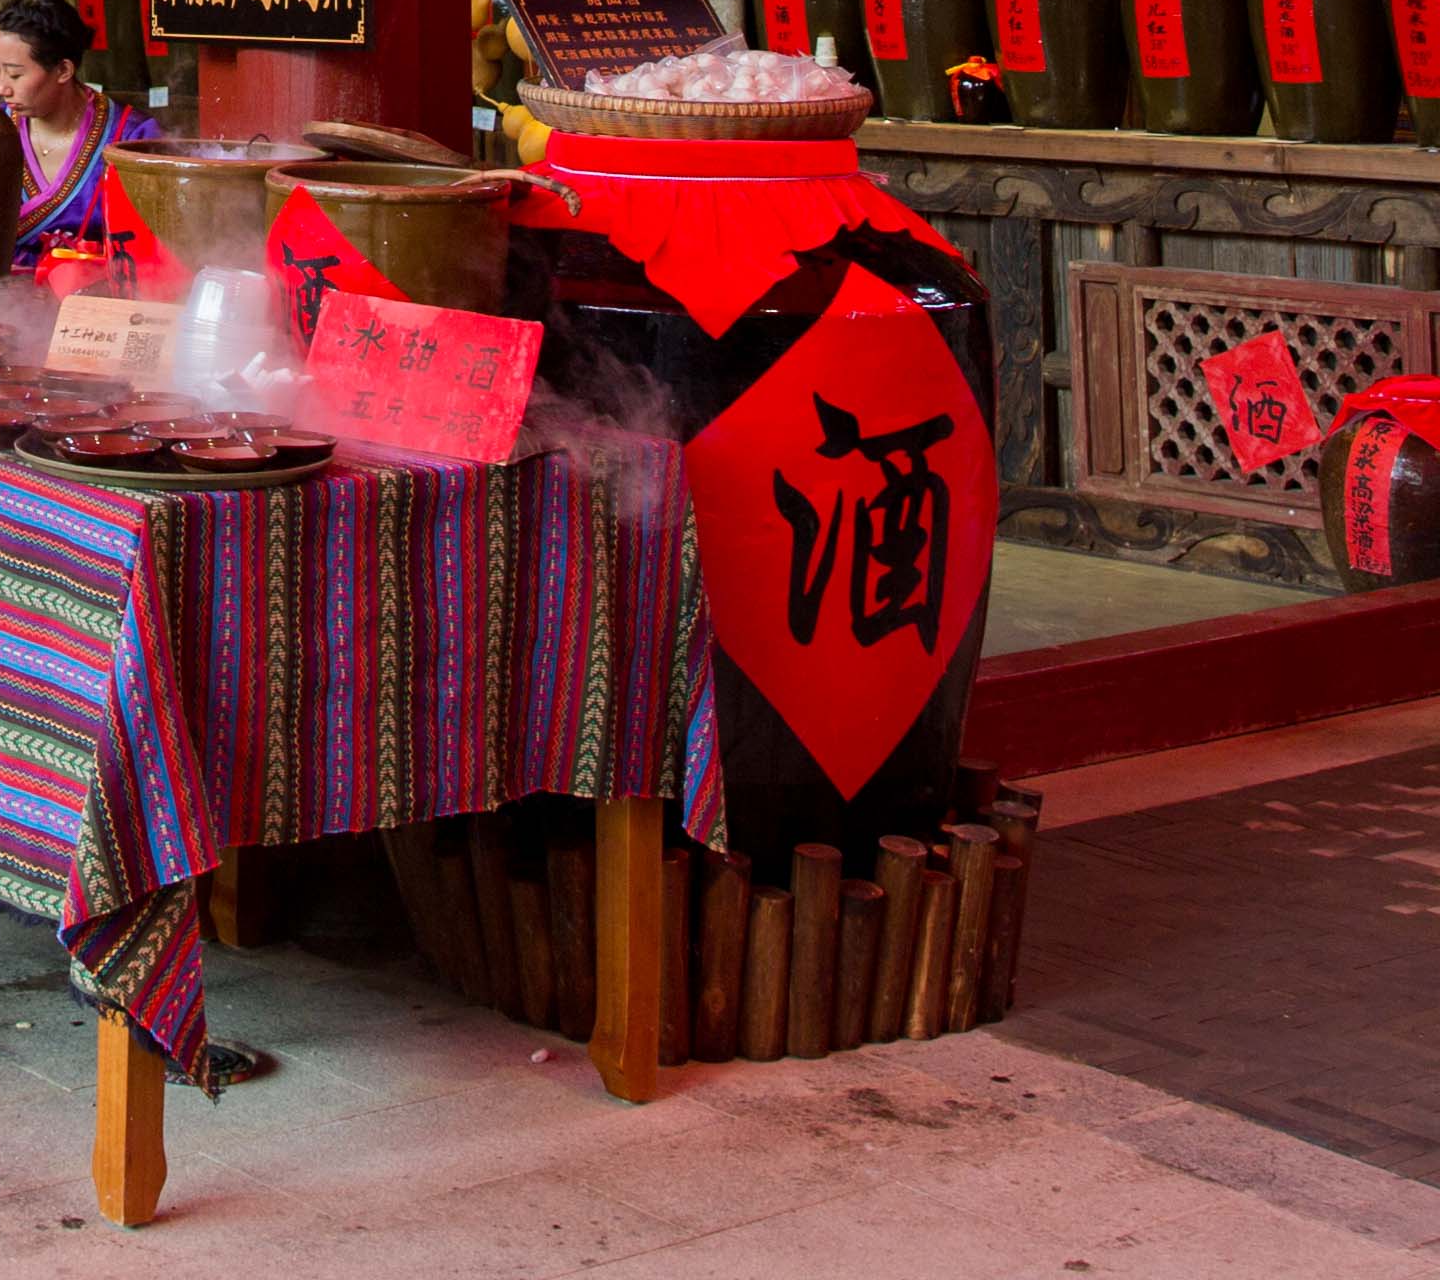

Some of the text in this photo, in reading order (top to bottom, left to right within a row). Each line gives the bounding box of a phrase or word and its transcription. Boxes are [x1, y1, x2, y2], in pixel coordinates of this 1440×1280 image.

[337, 318, 502, 391] 冰甜酒
[340, 390, 485, 444] 五元一碗
[1228, 374, 1288, 445] 酒
[773, 391, 954, 655] 酒
